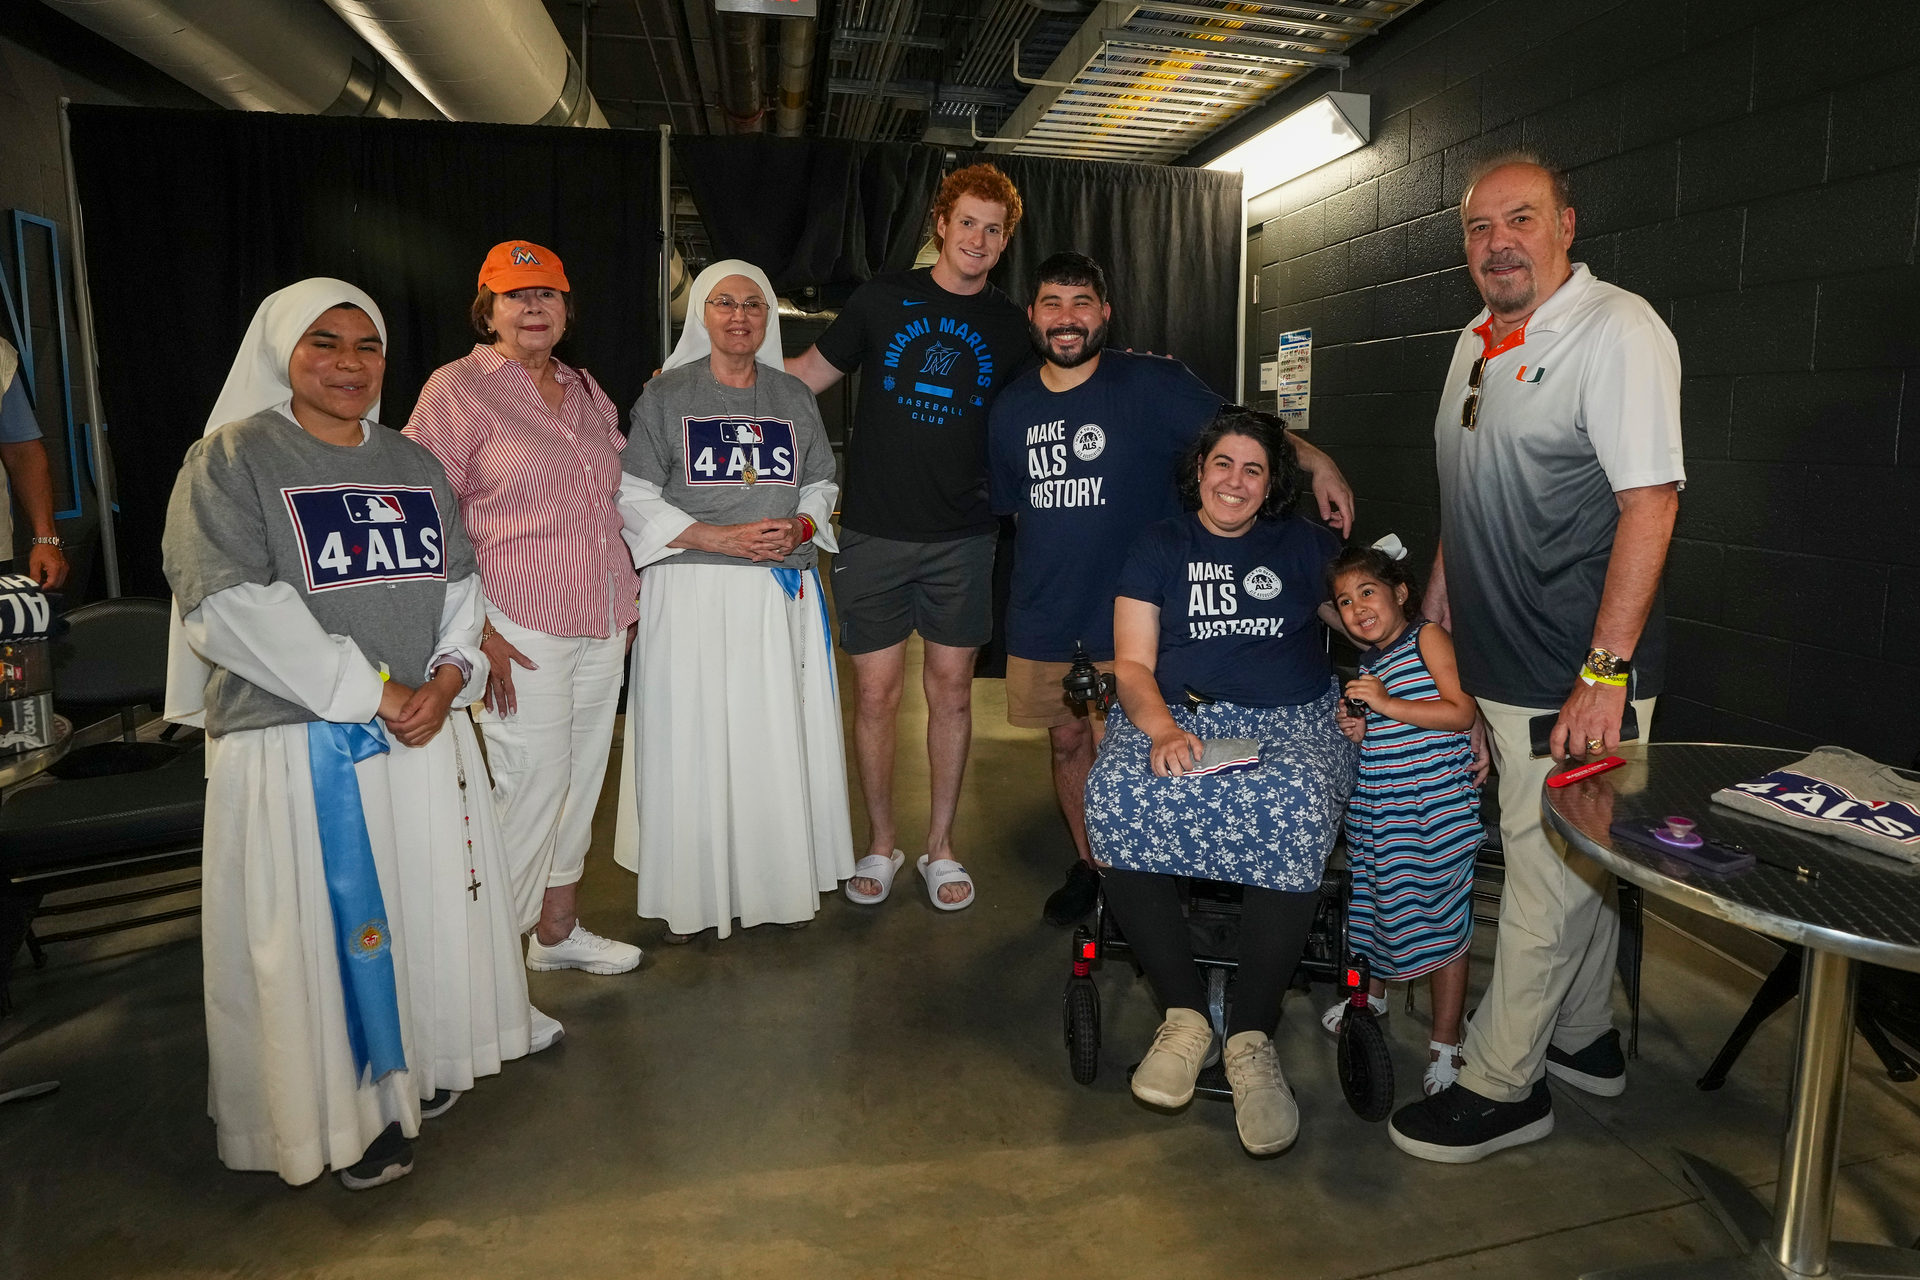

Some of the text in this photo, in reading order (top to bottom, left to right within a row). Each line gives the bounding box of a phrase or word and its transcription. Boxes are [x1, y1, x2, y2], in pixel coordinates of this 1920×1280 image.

[884, 317, 993, 388] MIAMI MARLINS
[897, 396, 963, 416] BASEBALL
[911, 412, 944, 425] CLUB
[1026, 419, 1066, 446] MAKE
[1081, 442, 1097, 451] ALS
[693, 446, 792, 477] 4 ALS
[1028, 444, 1067, 480] ALS
[1030, 476, 1106, 509] HISTORY.
[317, 526, 441, 576] 4 ALS
[1188, 561, 1235, 582] MAKE
[1255, 583, 1273, 591] ALS
[0, 592, 50, 634] AL
[1188, 583, 1238, 617] ALS
[1735, 782, 1916, 837] 4 ALS
